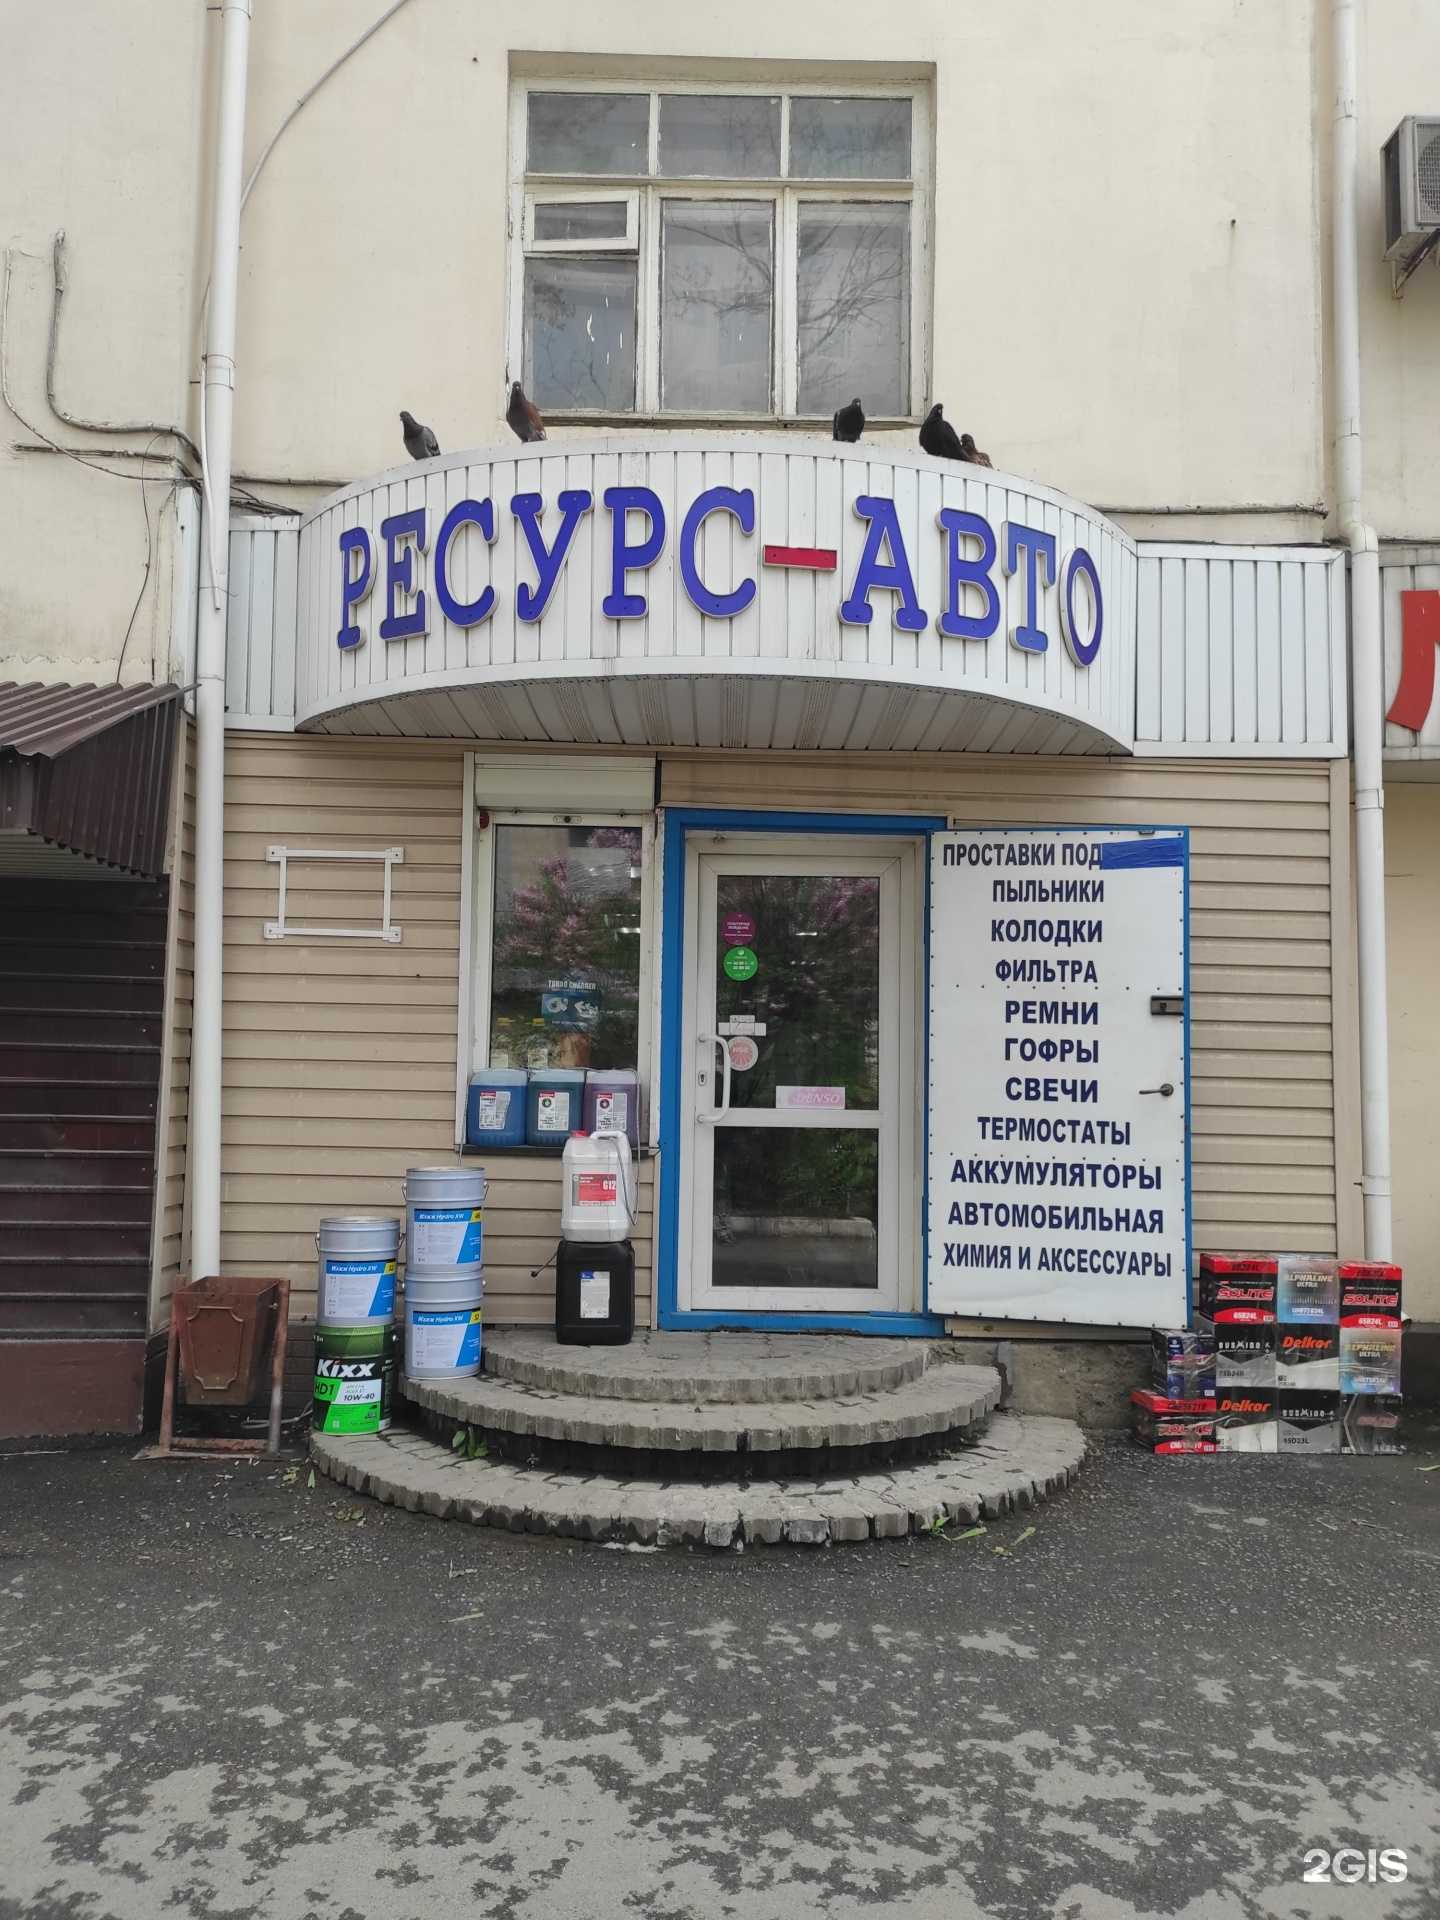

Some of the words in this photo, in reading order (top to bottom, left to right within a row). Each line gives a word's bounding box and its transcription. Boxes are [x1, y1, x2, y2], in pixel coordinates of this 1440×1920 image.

[336, 485, 1104, 669] РЕСУРС-АВТО
[943, 843, 1055, 866] ПРОСТАВКИ
[992, 879, 1105, 903] ПЫЛЬНИКИ
[991, 919, 1103, 947] КОЛОДКИ
[995, 958, 1098, 983] ФИЛЬТРА
[1005, 1000, 1099, 1025] РЕМНИ
[1004, 1037, 1099, 1063] ГОФРЫ
[1005, 1077, 1098, 1103] СВЕЧИ
[977, 1116, 1131, 1146] ТЕРМОСТАТЫ
[950, 1159, 1162, 1190] АККУМУЛЯТОРЫ
[948, 1202, 1164, 1234] АВТОМОБИЛЬНАЯ
[943, 1243, 1011, 1270] ХИМИЯ
[1018, 1247, 1031, 1270] И
[1038, 1247, 1172, 1277] АКСЕССУАРЫ
[1282, 1335, 1333, 1349] Delkor
[316, 1358, 376, 1378] Kixx
[315, 1382, 335, 1396] HD1
[343, 1392, 375, 1402] 10W-40
[1219, 1399, 1272, 1413] Delkor
